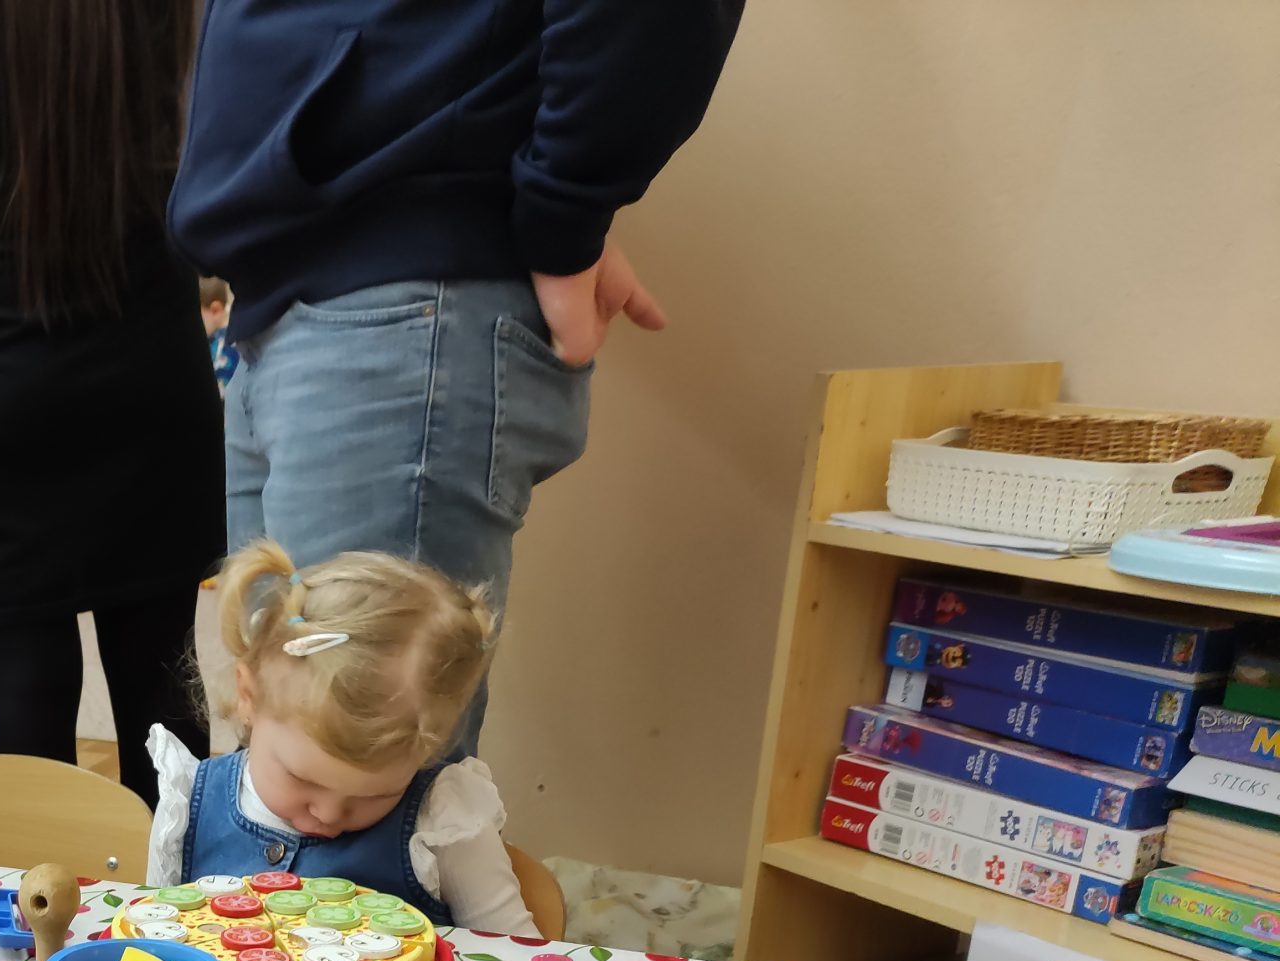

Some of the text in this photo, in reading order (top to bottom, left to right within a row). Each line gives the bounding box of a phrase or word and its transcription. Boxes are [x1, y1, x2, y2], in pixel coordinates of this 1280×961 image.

[1021, 659, 1035, 691] PUZZLE
[1013, 701, 1028, 734] PUZZLE
[972, 749, 987, 781] PUZZLE
[1209, 772, 1270, 797] STICKS
